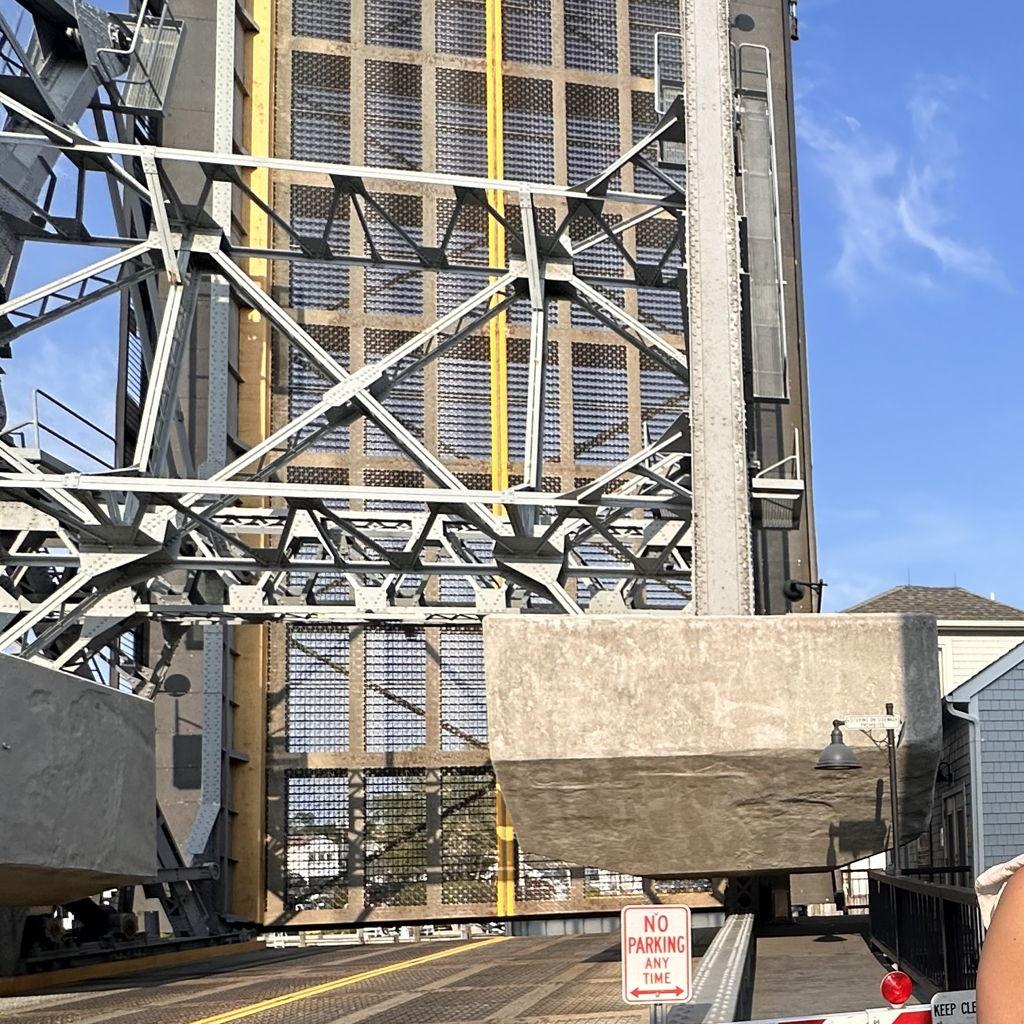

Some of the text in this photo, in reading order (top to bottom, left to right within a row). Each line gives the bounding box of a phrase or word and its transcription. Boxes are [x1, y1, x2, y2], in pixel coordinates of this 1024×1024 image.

[644, 914, 668, 933] NO
[628, 935, 685, 954] PARKING
[645, 957, 670, 969] ANY
[643, 972, 671, 985] TIME
[934, 1003, 956, 1017] KEEP
